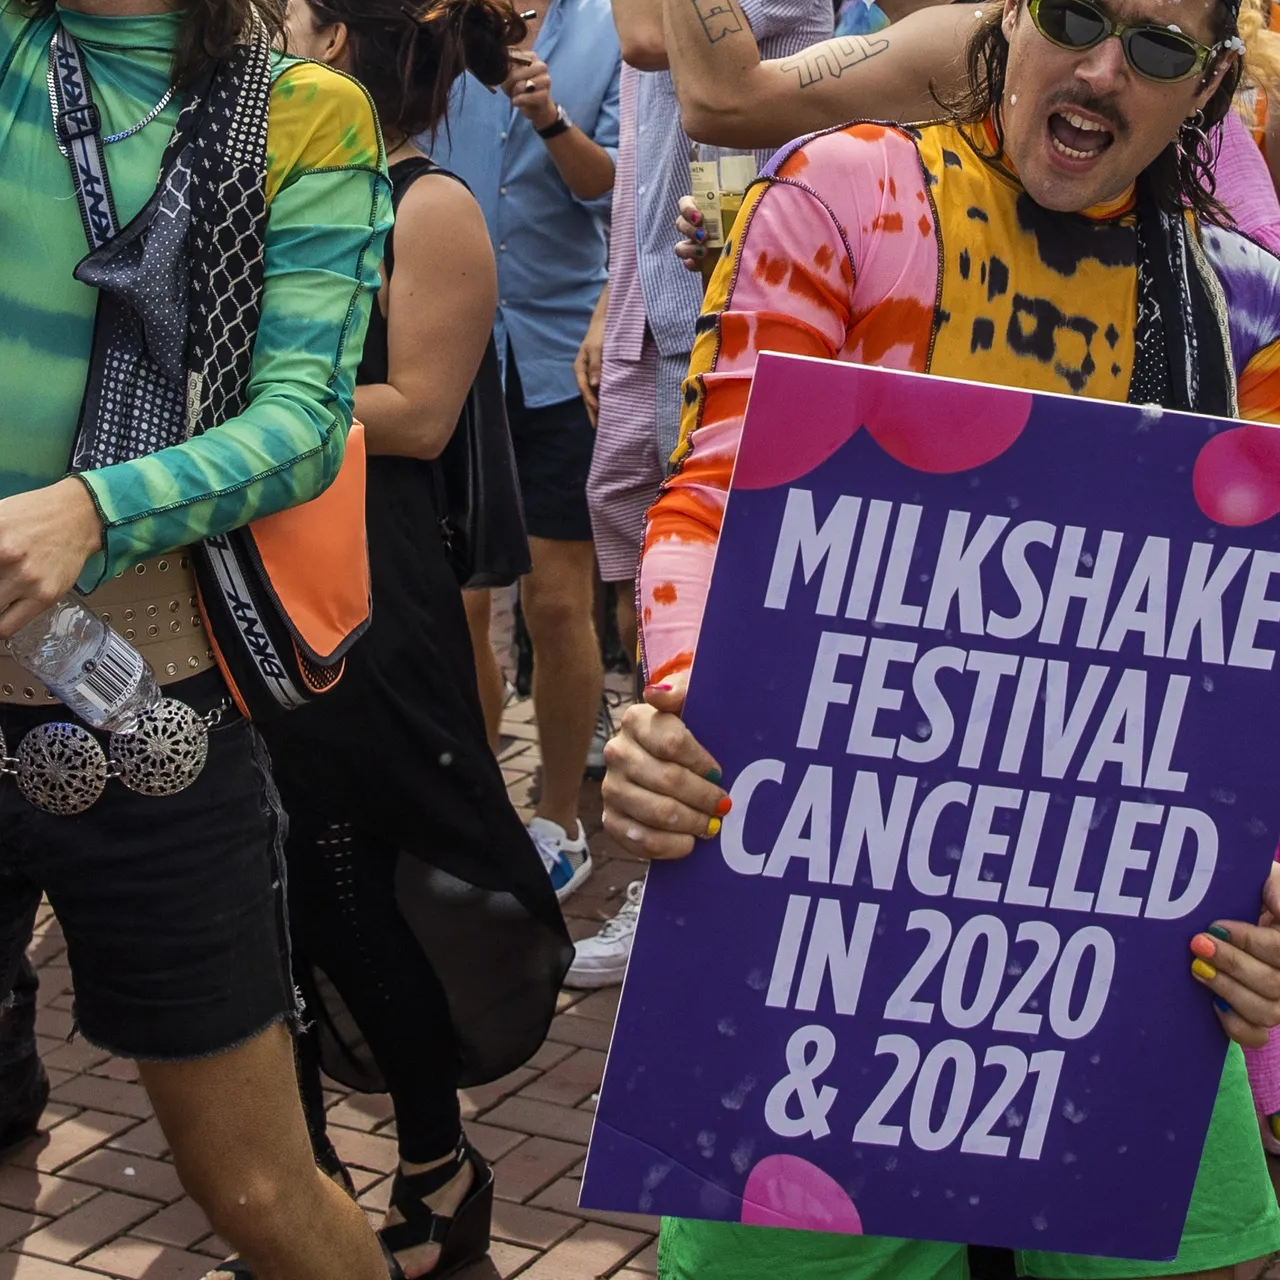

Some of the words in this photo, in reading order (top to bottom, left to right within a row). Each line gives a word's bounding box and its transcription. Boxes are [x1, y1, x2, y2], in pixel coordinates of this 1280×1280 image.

[78, 163, 111, 243] KNY
[223, 589, 287, 680] DKNY
[796, 632, 1190, 791] FESTIVAL
[719, 759, 1218, 920] CANCELLED
[765, 894, 880, 1016] IN
[883, 914, 1115, 1039] 2020
[765, 1025, 838, 1140] &
[852, 1037, 1065, 1160] 2021
